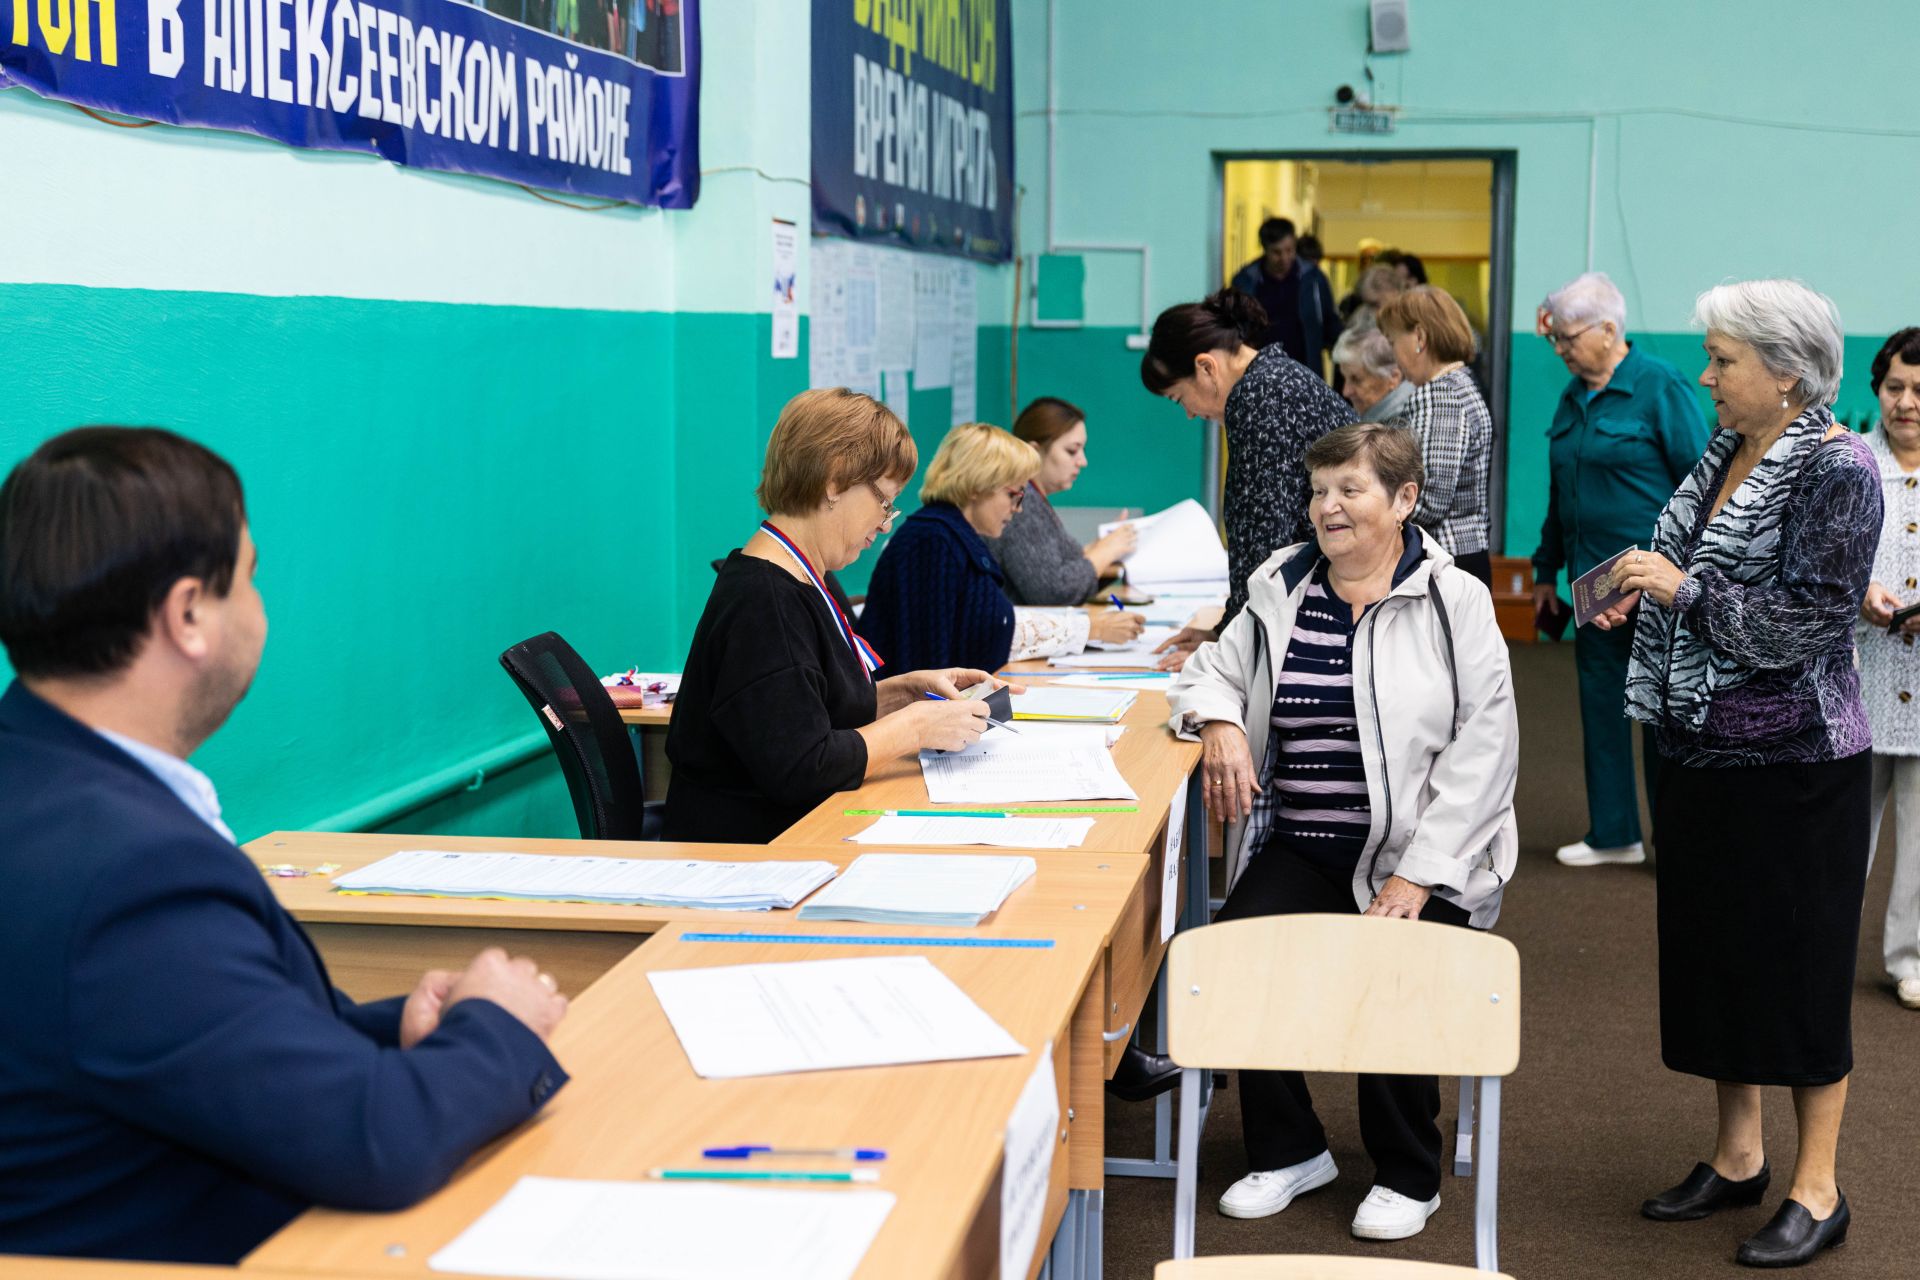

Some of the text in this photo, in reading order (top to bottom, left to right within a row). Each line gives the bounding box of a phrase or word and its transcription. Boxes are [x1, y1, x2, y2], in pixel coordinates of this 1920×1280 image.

[203, 0, 519, 152] АЛЕКСЕЕВСКОМ
[525, 51, 632, 176] РАЙОНЕ
[853, 52, 929, 194] ВРЕМЯ
